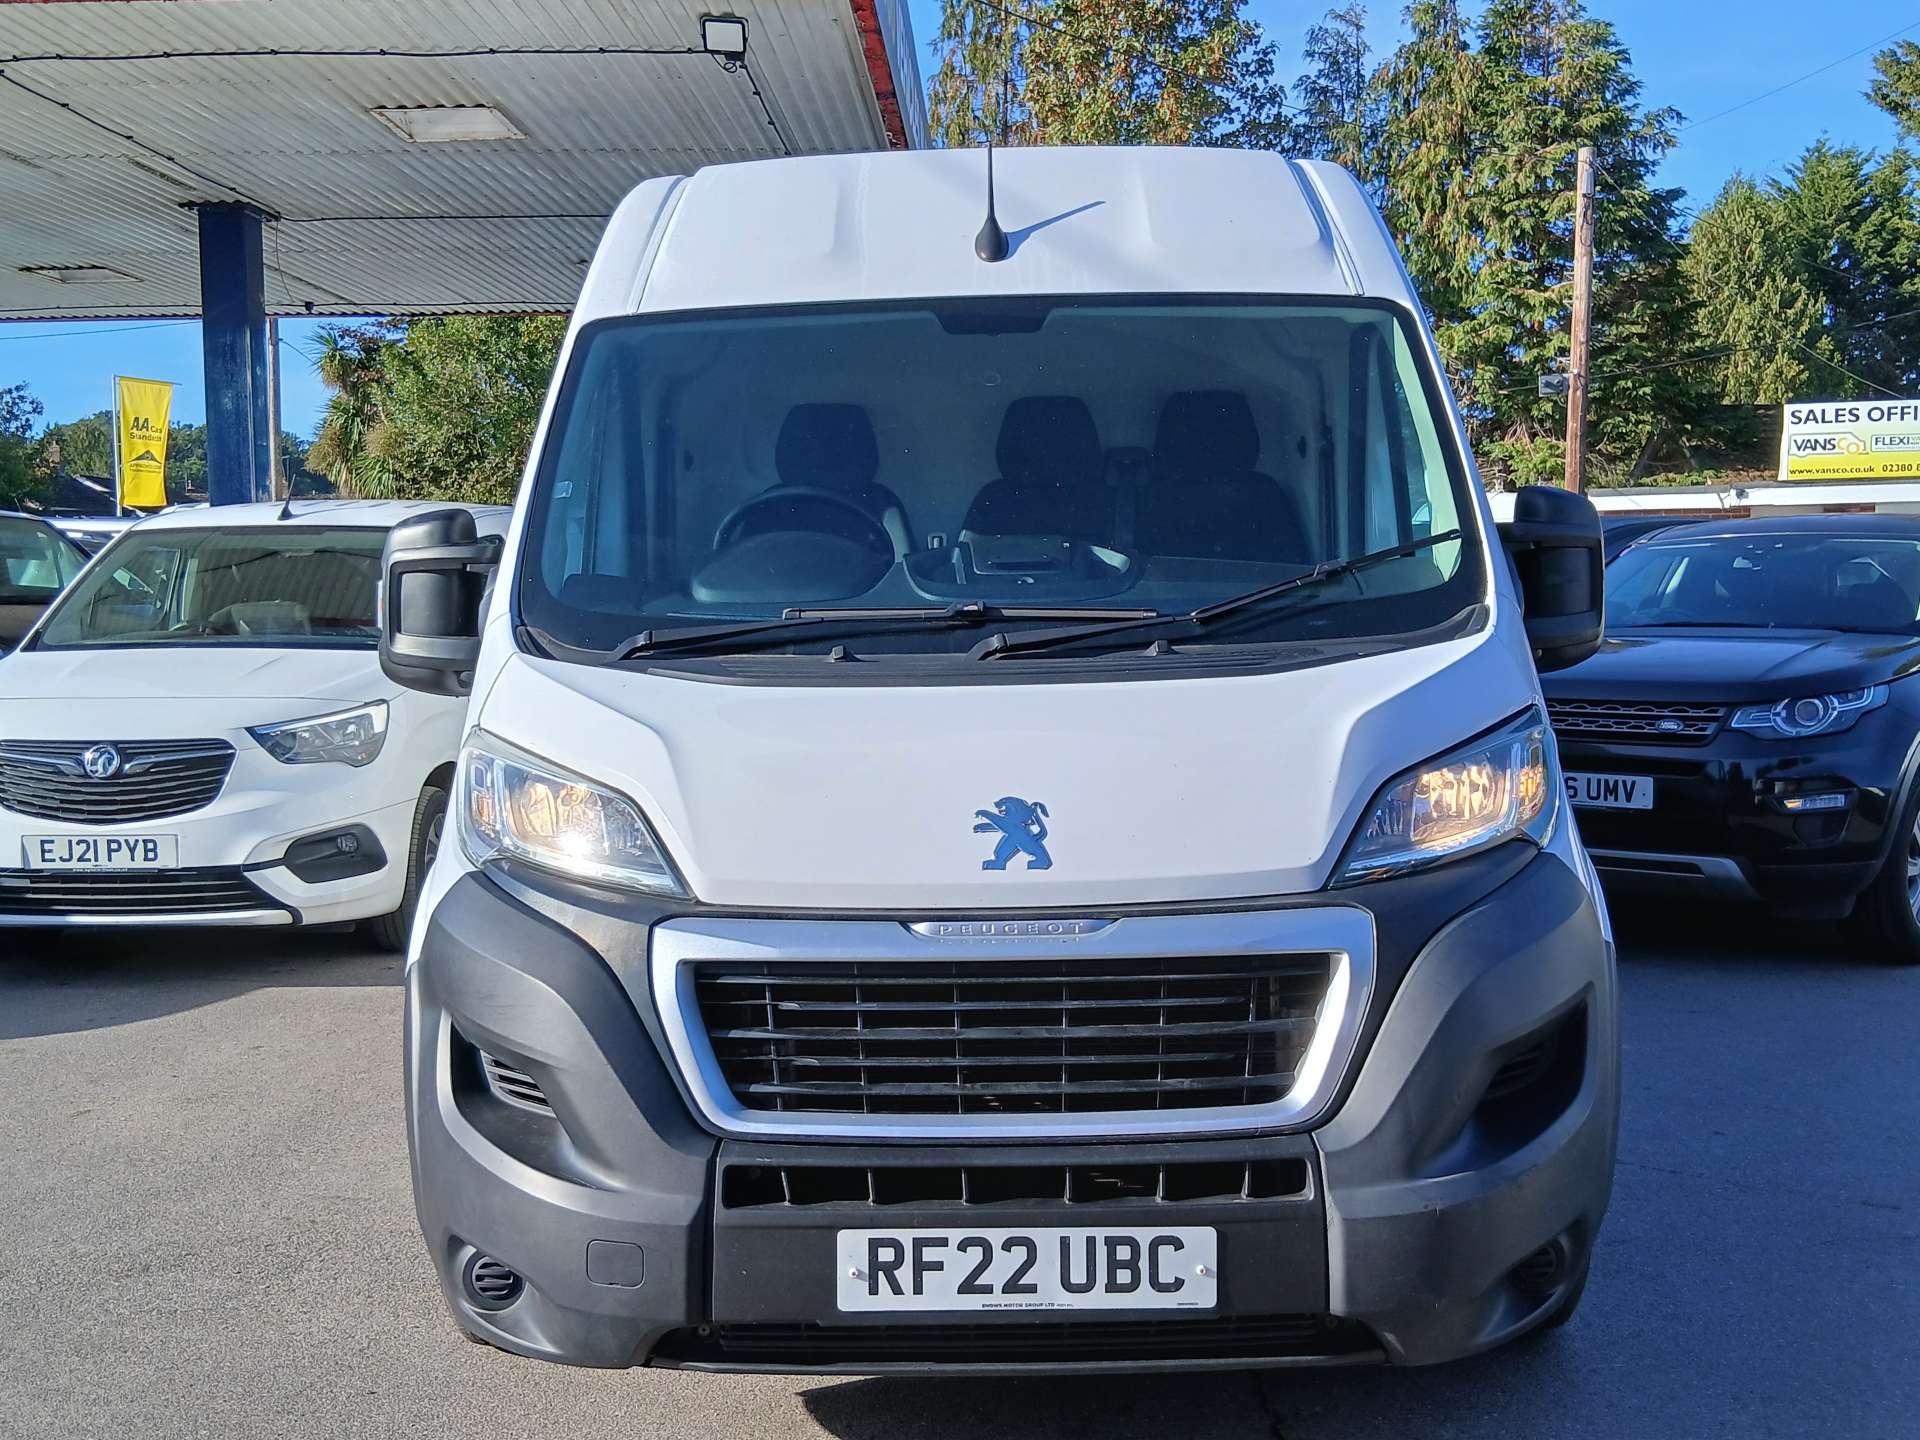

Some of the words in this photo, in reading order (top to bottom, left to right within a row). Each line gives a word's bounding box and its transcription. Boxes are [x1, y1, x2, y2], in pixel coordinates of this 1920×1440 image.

[130, 416, 149, 432] AA
[1790, 407, 1860, 425] SALES
[1867, 405, 1919, 422] OFFI
[1875, 436, 1910, 446] FLEXI
[1789, 465, 1875, 475] www.vansco.co.uk
[1882, 463, 1913, 473] 02380
[1586, 777, 1636, 803] UMV
[39, 839, 98, 863] EJ21
[106, 838, 159, 863] PYB
[938, 922, 1084, 936] PEUGEOT
[867, 1236, 1038, 1296] RF22
[1059, 1235, 1186, 1294] UBC
